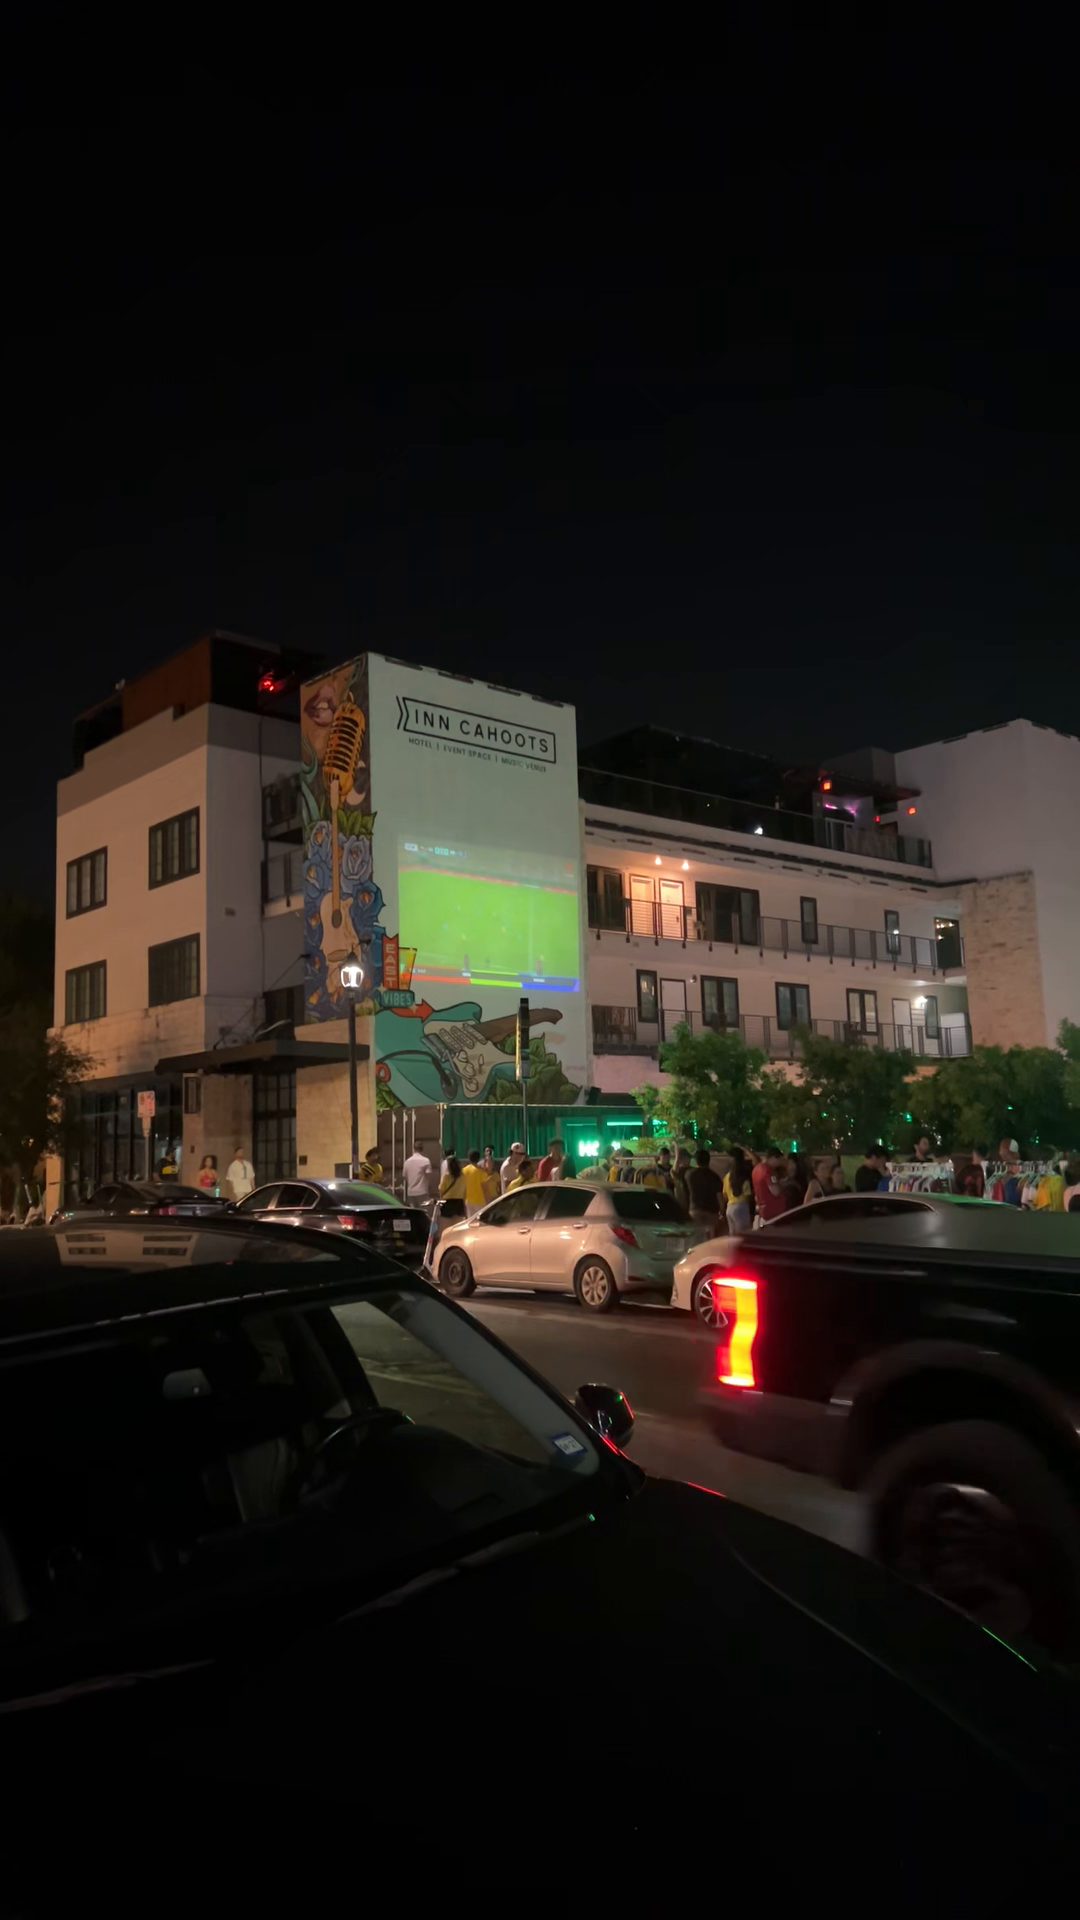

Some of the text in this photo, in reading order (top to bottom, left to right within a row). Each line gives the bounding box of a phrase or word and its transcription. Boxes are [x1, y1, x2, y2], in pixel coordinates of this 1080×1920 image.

[415, 709, 549, 753] INN CAHOOTS
[408, 737, 433, 749] HOTEL
[443, 745, 466, 756] EVENT
[468, 751, 491, 761] SPACE
[501, 757, 524, 768] MUSIC
[525, 763, 547, 773] VENUE
[385, 943, 396, 987] EAST
[383, 992, 412, 1006] VIBES
